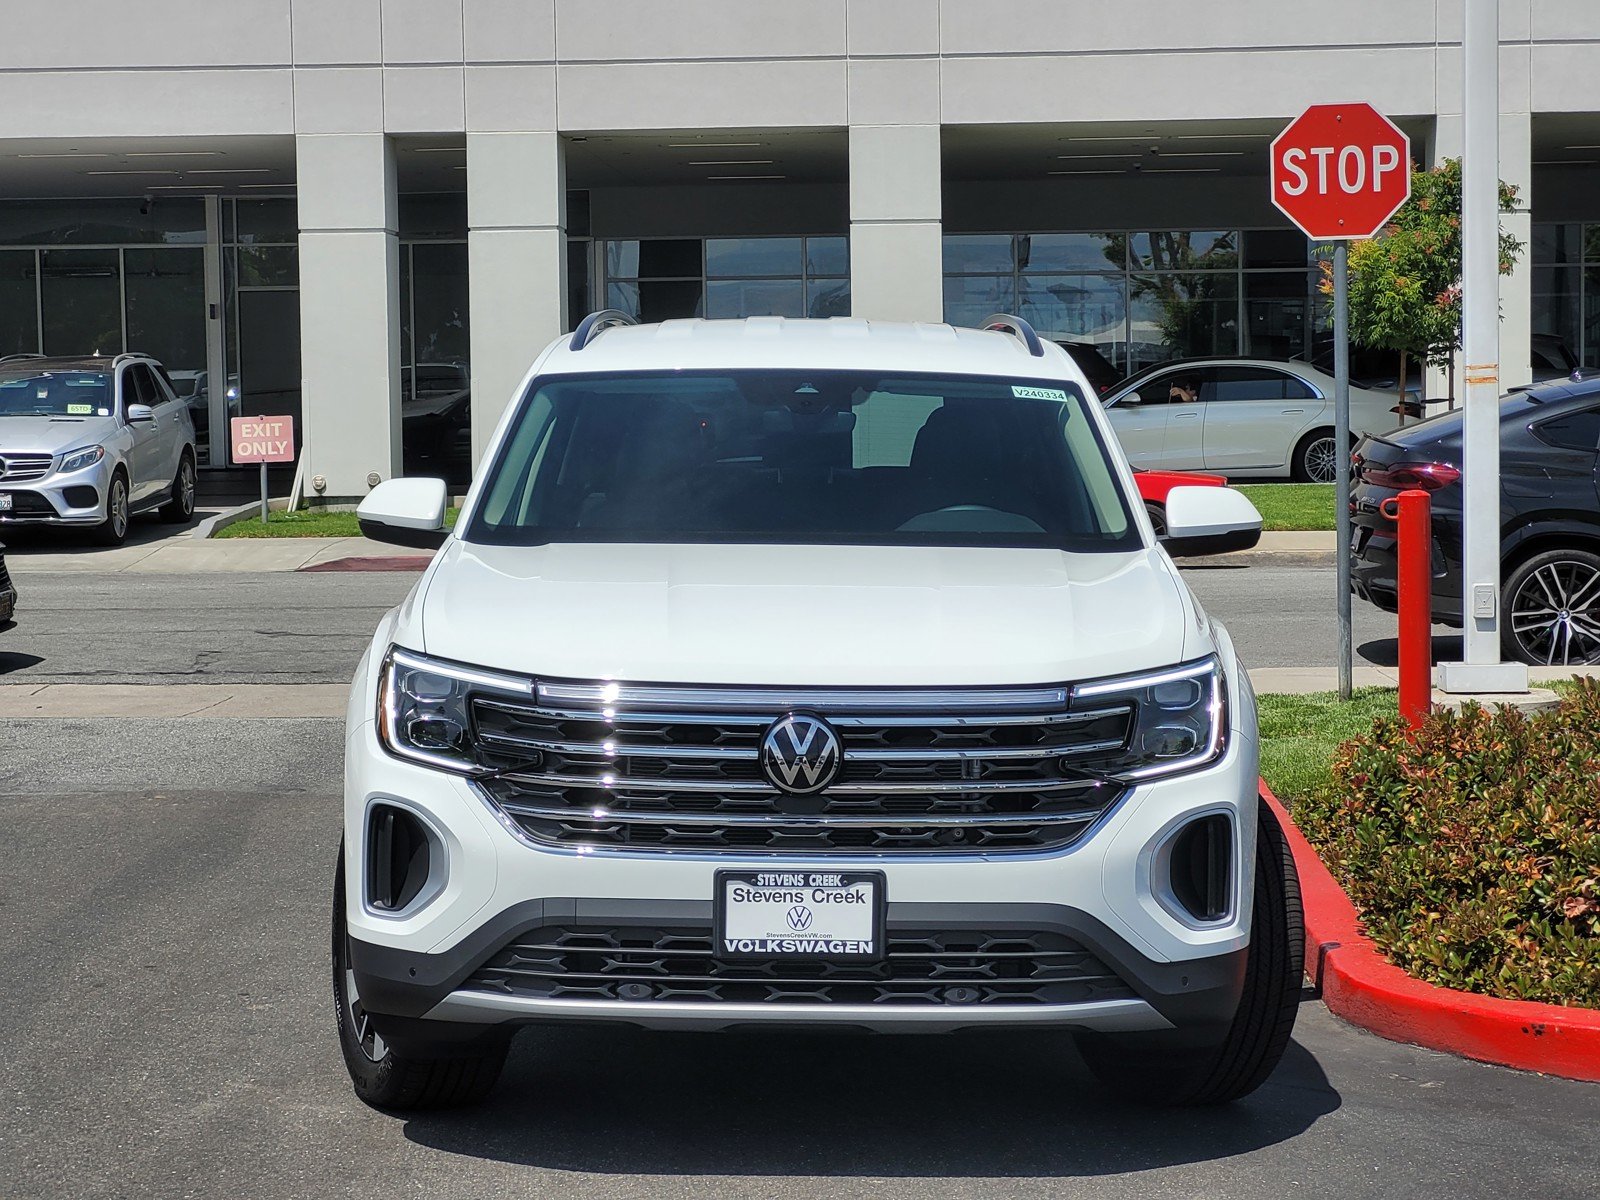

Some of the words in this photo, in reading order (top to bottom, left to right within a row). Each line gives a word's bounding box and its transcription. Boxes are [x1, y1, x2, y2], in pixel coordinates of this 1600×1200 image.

[1281, 144, 1399, 196] STOP
[1014, 387, 1065, 400] V240334
[241, 422, 283, 438] EXIT
[237, 440, 288, 456] ONLY
[757, 873, 804, 887] STEVENS
[809, 874, 842, 887] CREEK
[732, 887, 804, 903] Stevens
[811, 889, 866, 904] Creek
[724, 939, 873, 954] VOLKSWAGEN
